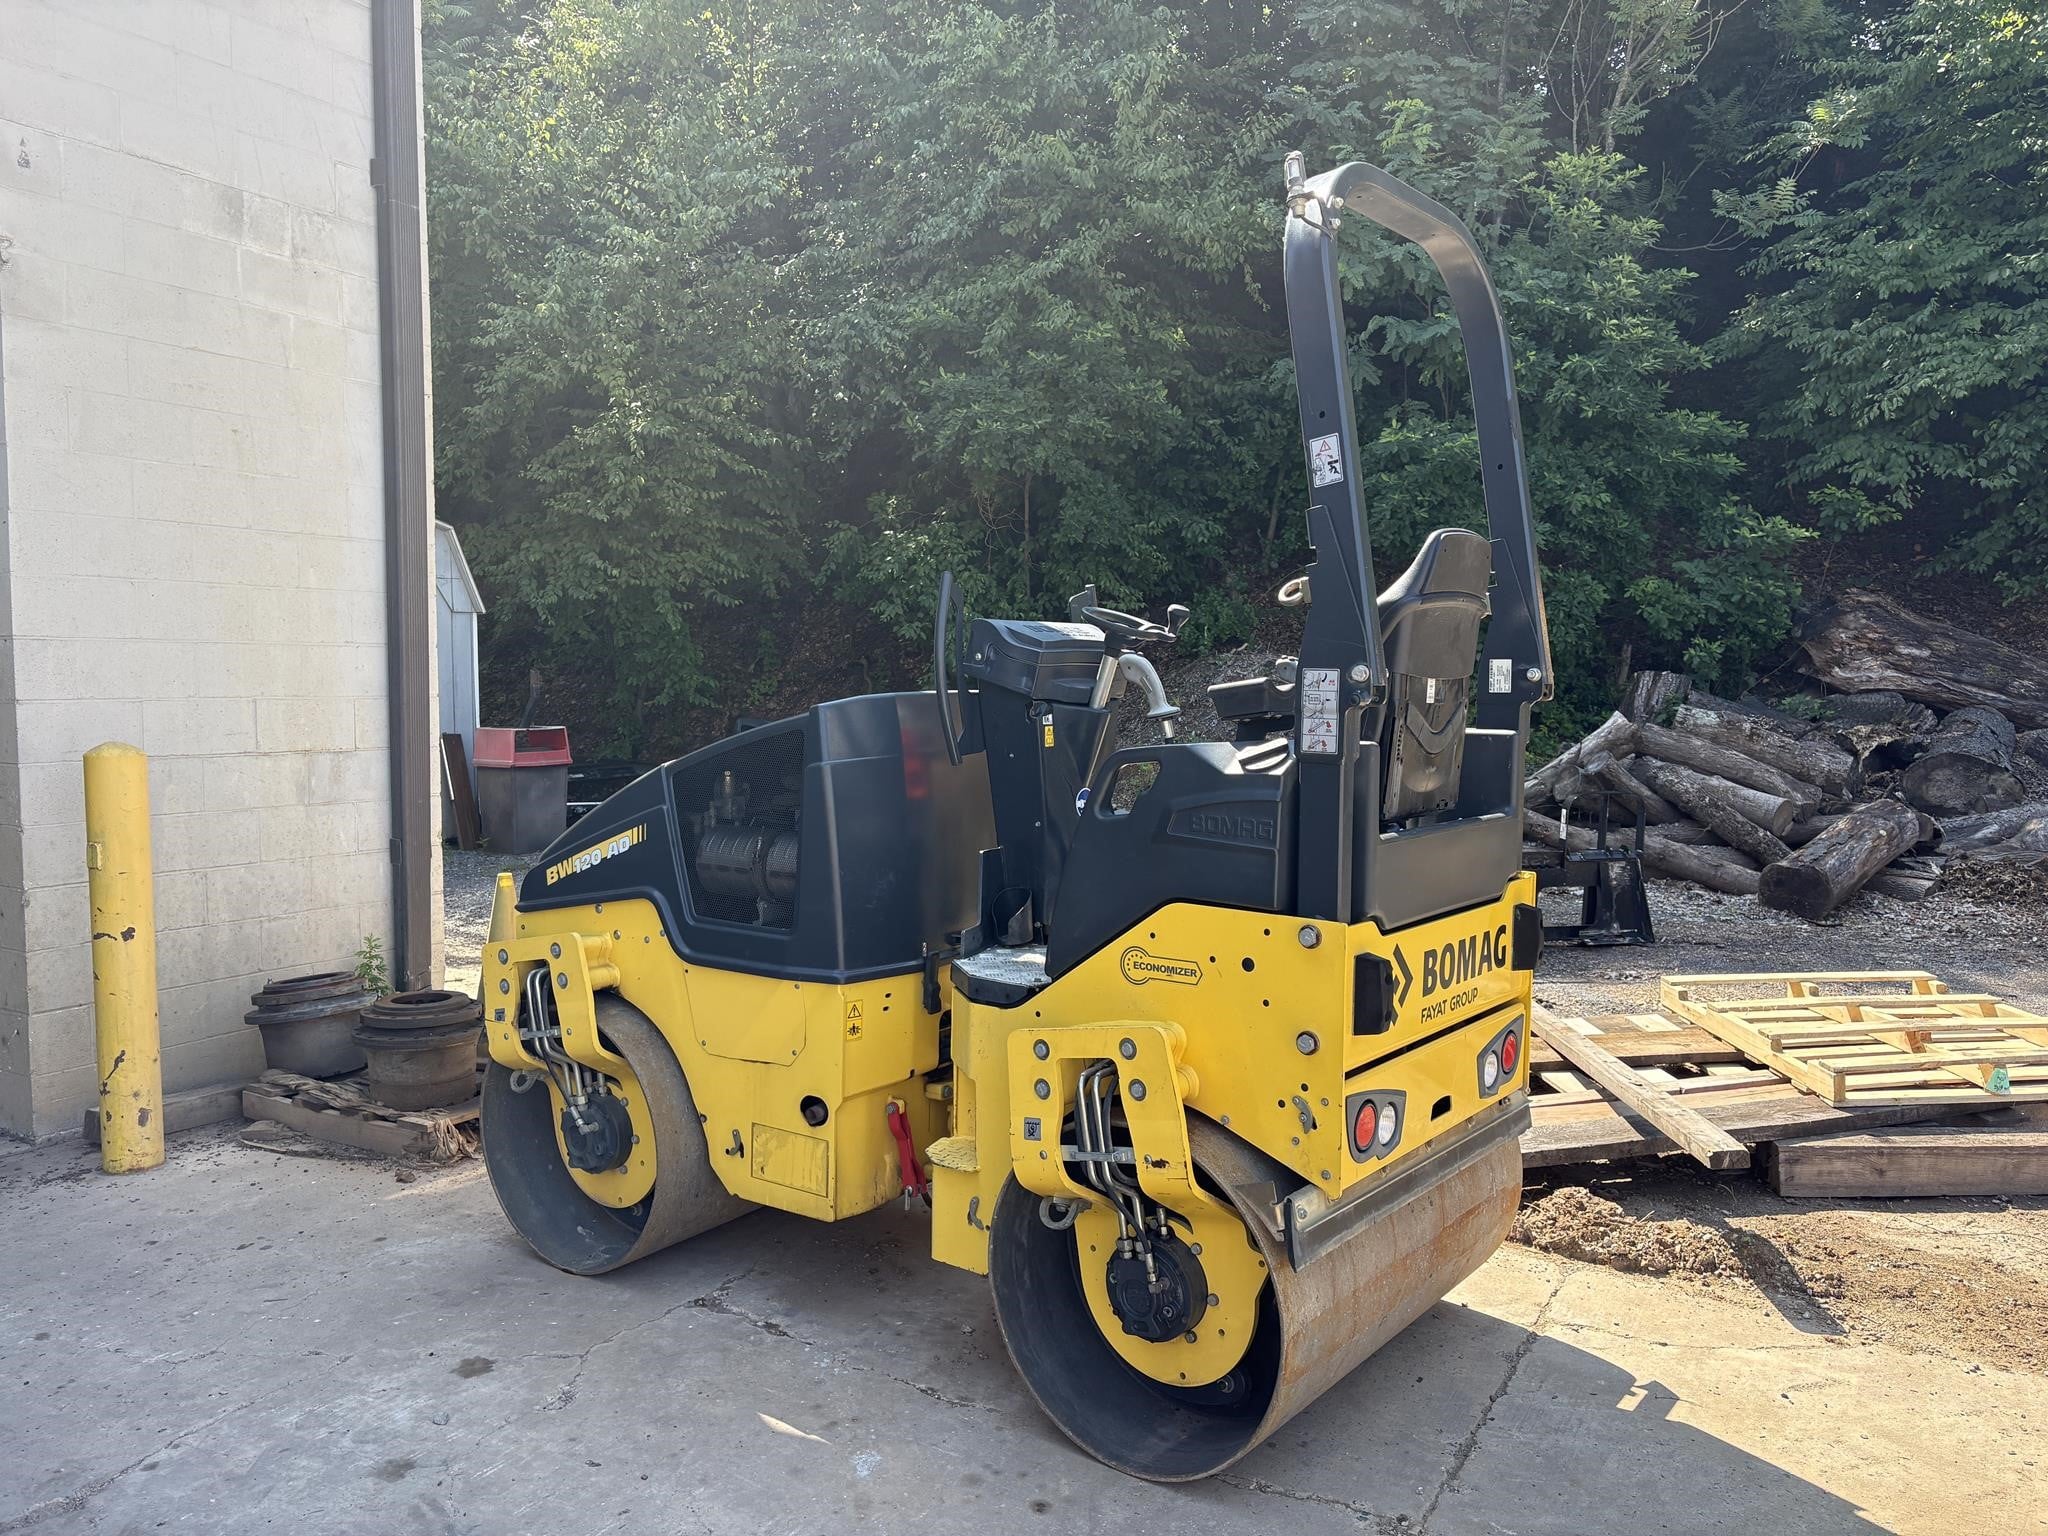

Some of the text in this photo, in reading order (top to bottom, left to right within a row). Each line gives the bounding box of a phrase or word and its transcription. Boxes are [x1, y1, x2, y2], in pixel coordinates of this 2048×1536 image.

[1192, 813, 1274, 841] BOMAG
[606, 835, 631, 860] AD
[1133, 960, 1198, 978] ECONOMIZER
[1422, 924, 1507, 998] BOMAG
[1420, 987, 1479, 1025] FAYAT GROUP
